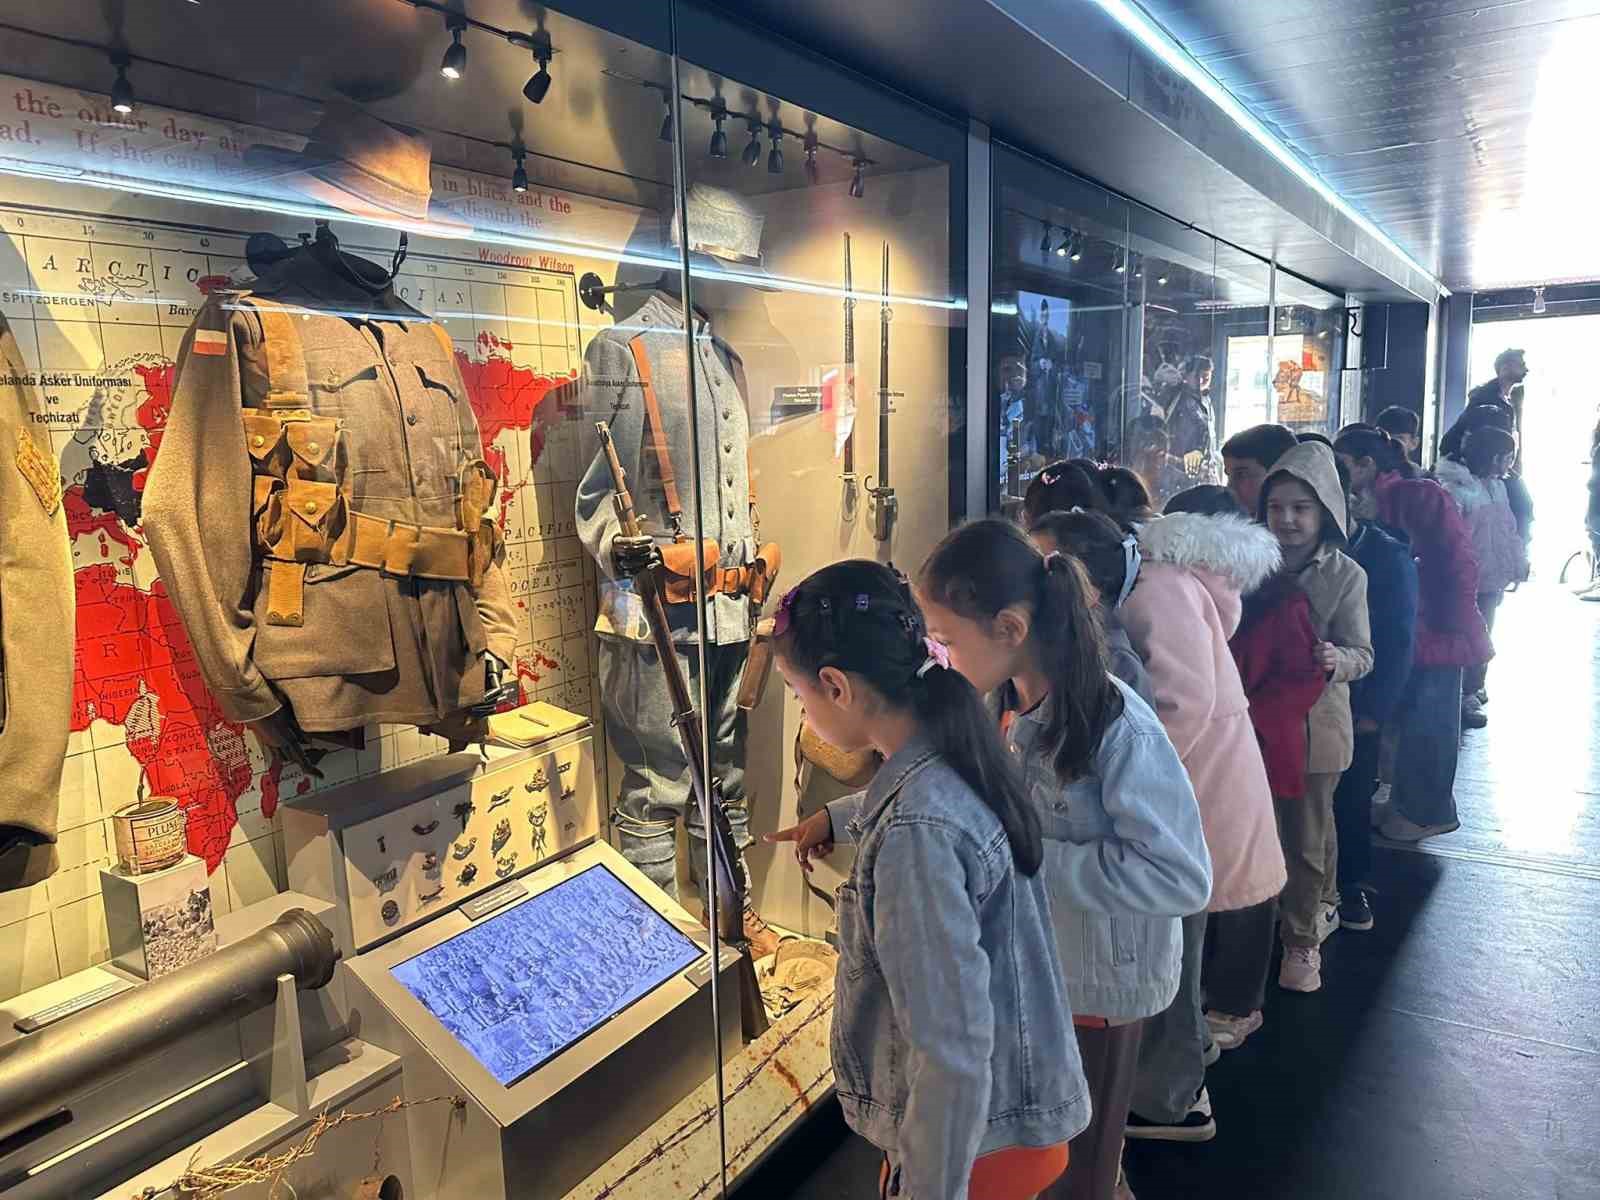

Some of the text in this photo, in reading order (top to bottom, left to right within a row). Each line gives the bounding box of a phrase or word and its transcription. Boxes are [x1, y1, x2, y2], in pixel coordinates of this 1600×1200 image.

[0, 119, 41, 145] ad.
[14, 88, 62, 119] the
[163, 116, 206, 152] day
[441, 174, 458, 193] in
[517, 190, 545, 209] and
[550, 193, 573, 214] the
[42, 255, 200, 283] ARCTIC
[478, 247, 575, 272] Woodrow Wilson
[0, 374, 37, 386] elanda
[39, 375, 72, 387] Asker
[46, 395, 60, 404] ve
